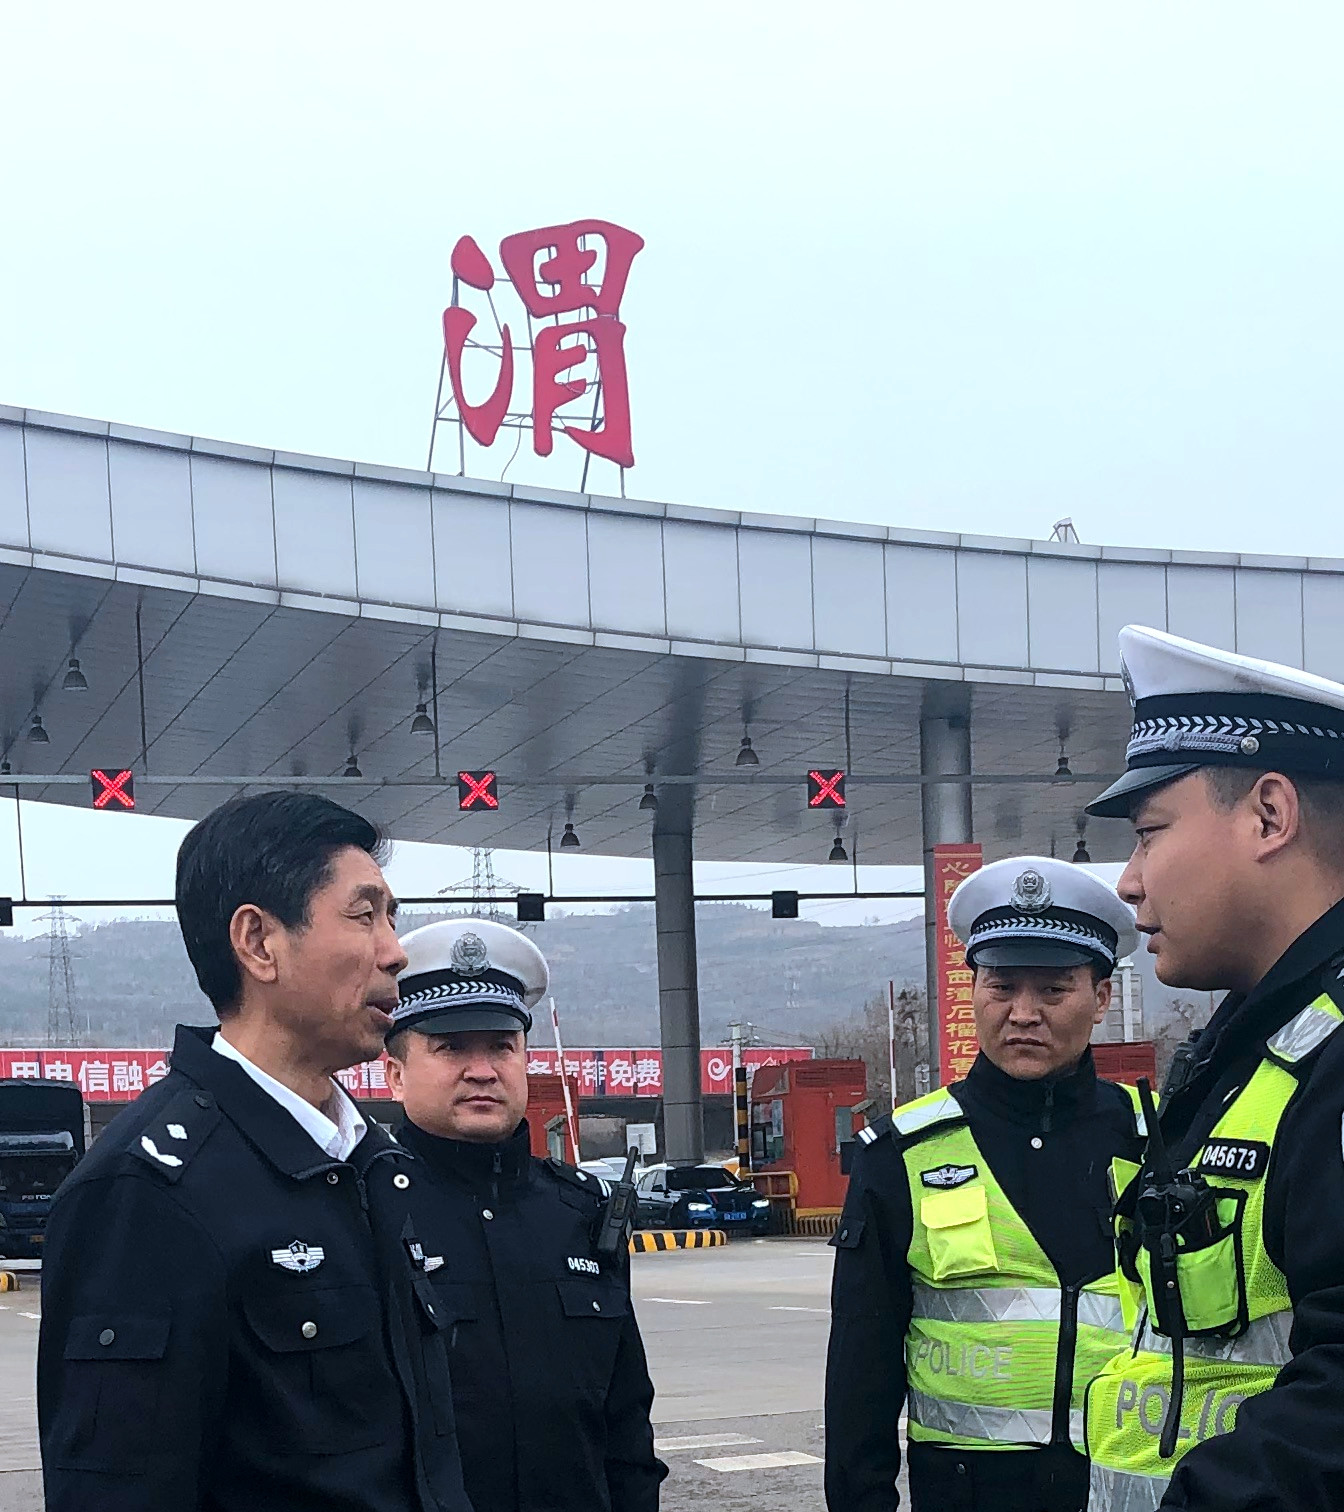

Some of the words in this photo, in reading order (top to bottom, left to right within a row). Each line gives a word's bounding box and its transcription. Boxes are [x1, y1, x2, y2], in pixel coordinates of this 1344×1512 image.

[442, 218, 645, 468] 渭
[1201, 1145, 1257, 1171] 045673
[913, 1336, 1013, 1380] POLICE
